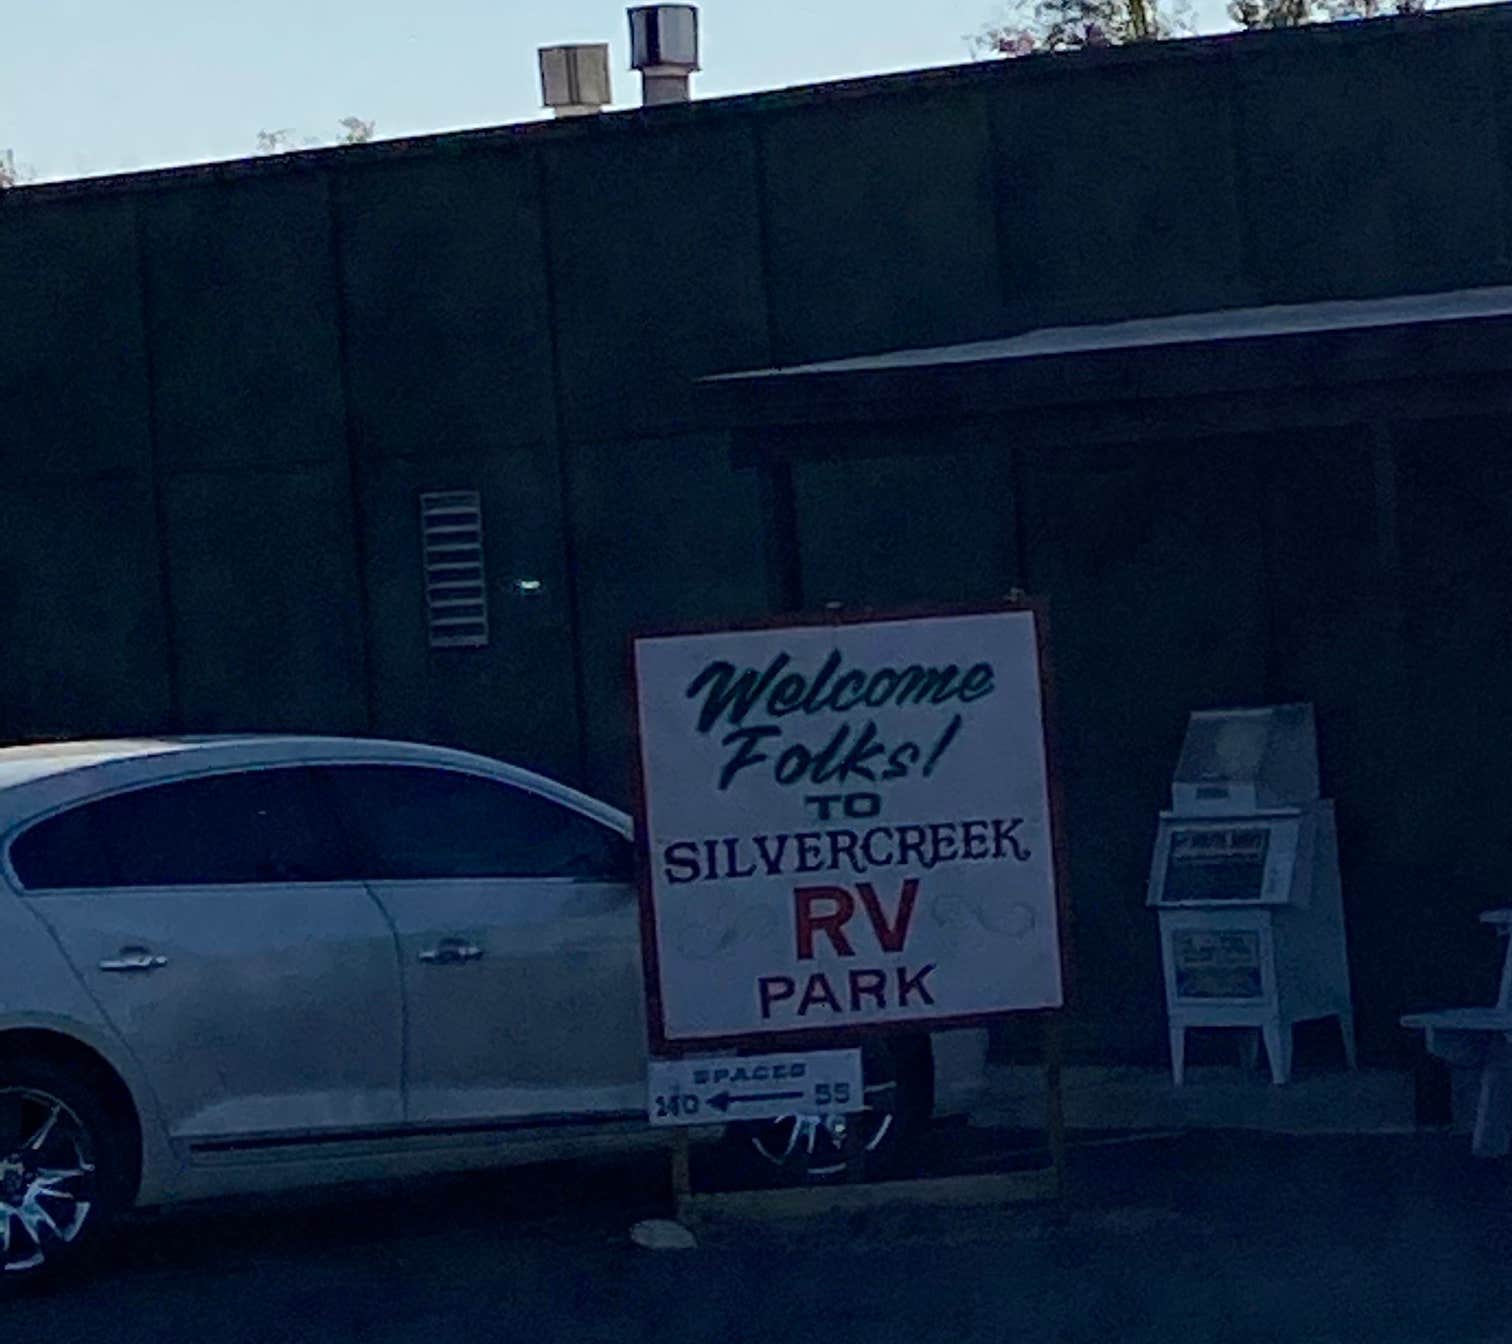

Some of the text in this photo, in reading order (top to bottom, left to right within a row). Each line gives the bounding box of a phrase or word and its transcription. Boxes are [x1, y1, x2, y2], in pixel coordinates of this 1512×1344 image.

[686, 649, 996, 732] Welcome
[718, 714, 962, 790] Folks!
[807, 792, 881, 820] TO
[664, 818, 1032, 885] SILVERCREEK
[793, 878, 921, 960] RV
[758, 963, 937, 1019] PARK
[693, 1063, 806, 1084] SPACES
